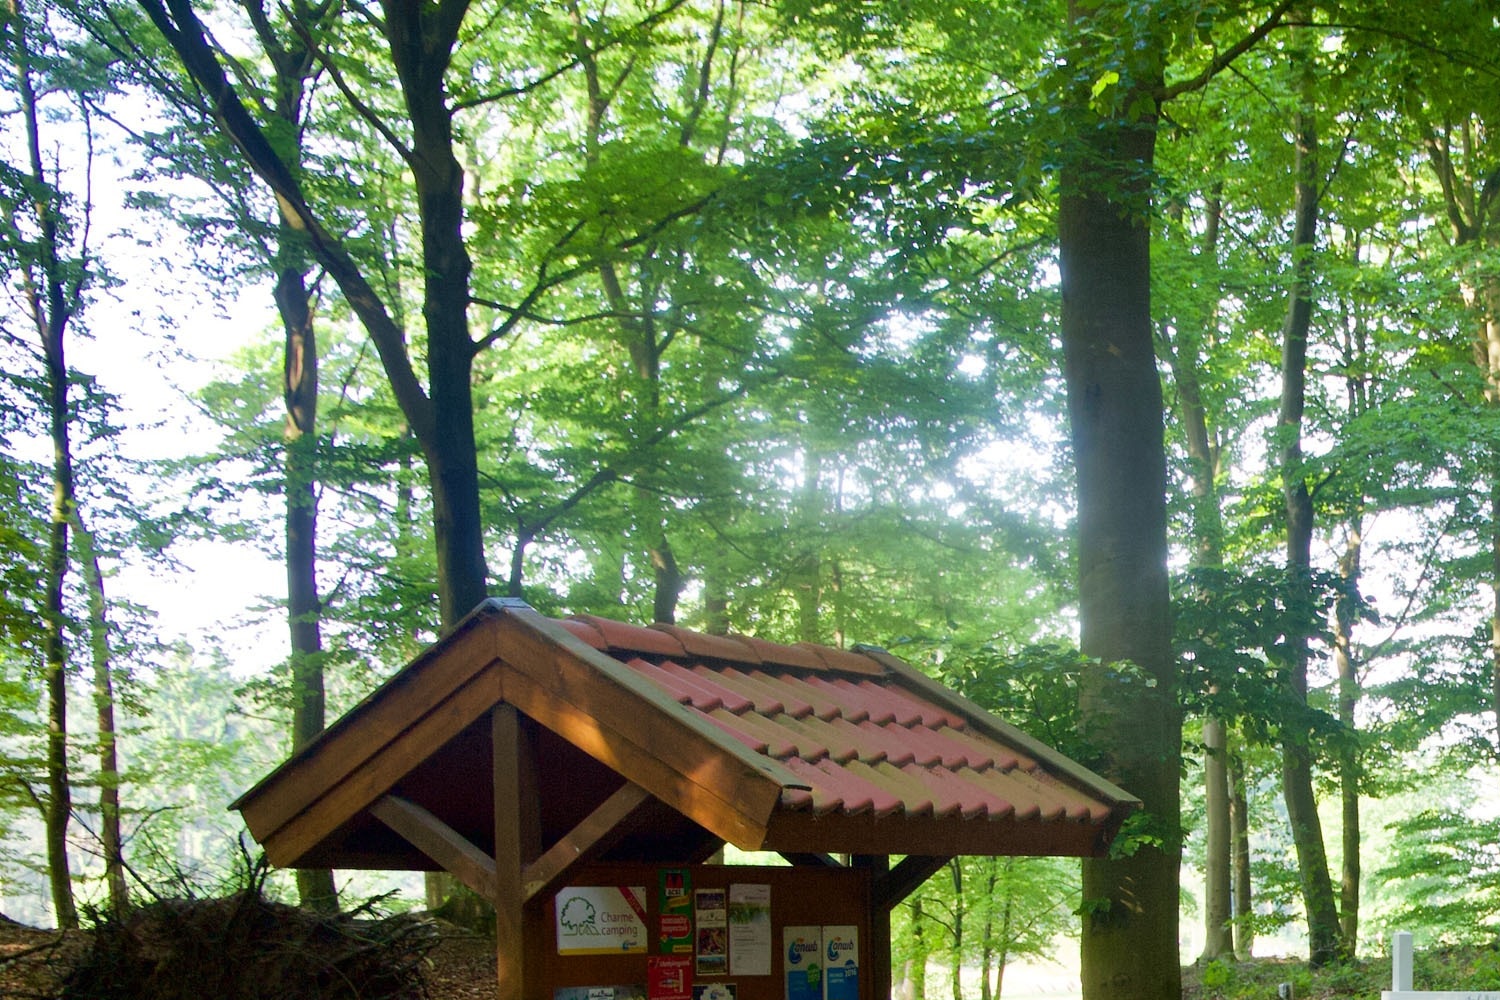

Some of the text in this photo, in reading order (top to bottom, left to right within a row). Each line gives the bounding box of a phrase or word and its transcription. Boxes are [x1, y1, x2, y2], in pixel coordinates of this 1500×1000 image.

[601, 912, 634, 923] Charme
[601, 926, 638, 938] camping
[794, 940, 818, 952] anwb
[832, 939, 854, 950] anwb
